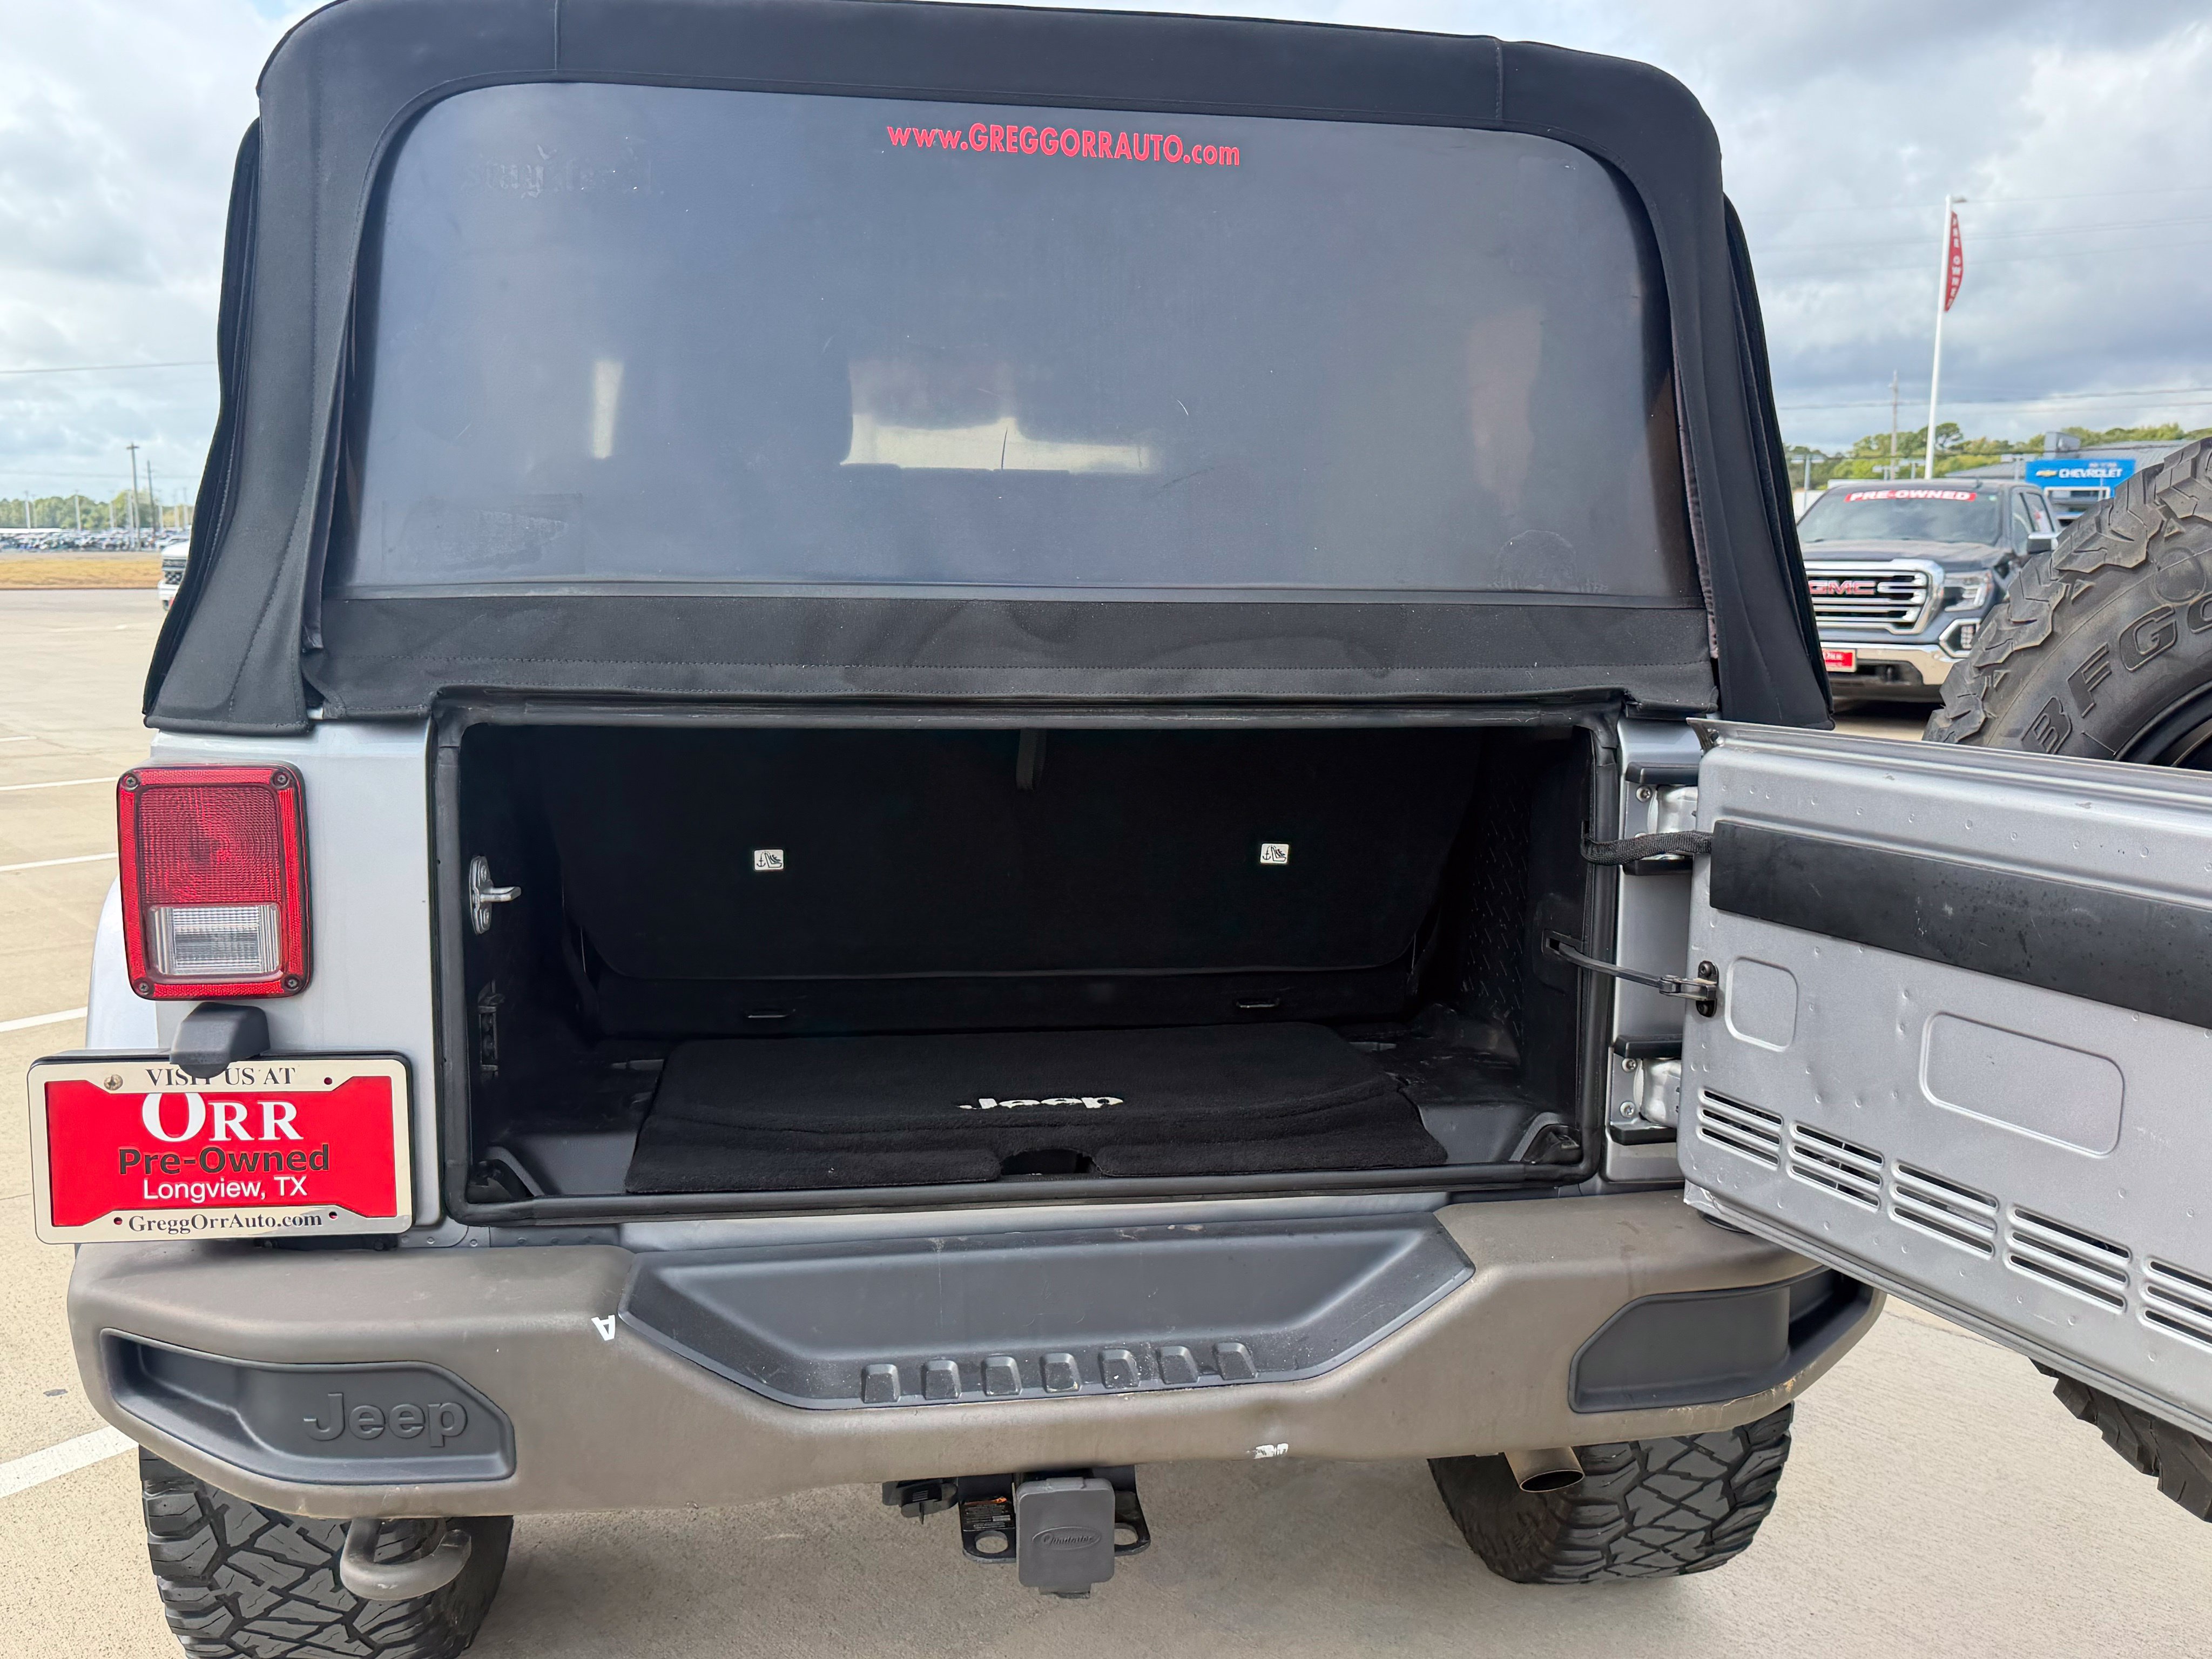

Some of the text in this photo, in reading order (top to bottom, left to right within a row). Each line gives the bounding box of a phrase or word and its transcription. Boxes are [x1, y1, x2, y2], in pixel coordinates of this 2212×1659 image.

[887, 122, 1240, 166] www.GREGGORRAUTO.com
[2058, 468, 2123, 478] CHEVROLET
[1850, 490, 1971, 501] PRE-OWNED
[1808, 580, 1876, 595] GMC
[224, 1068, 255, 1085] US
[263, 1067, 296, 1084] AT
[142, 1092, 305, 1143] ORR
[118, 1143, 330, 1176] Pre-Owned
[143, 1175, 308, 1204] Longview, TX
[128, 1212, 322, 1235] GreggOrrAuto.com
[304, 1392, 468, 1448] Jeep
